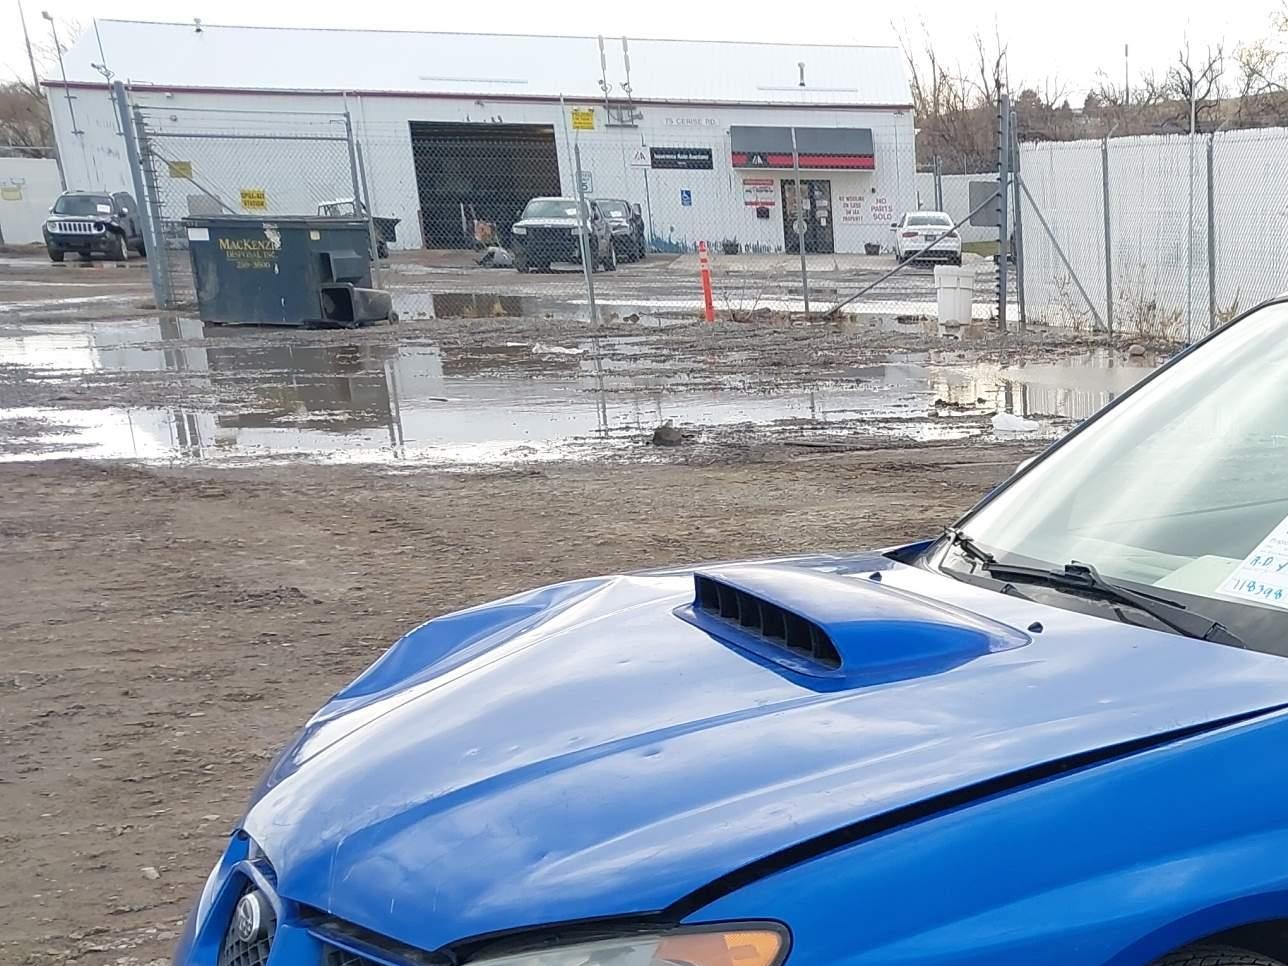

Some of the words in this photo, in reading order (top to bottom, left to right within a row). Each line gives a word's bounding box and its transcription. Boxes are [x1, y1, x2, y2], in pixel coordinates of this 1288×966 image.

[875, 197, 888, 205] NO
[870, 205, 893, 213] PARTS
[872, 213, 893, 221] SOLD
